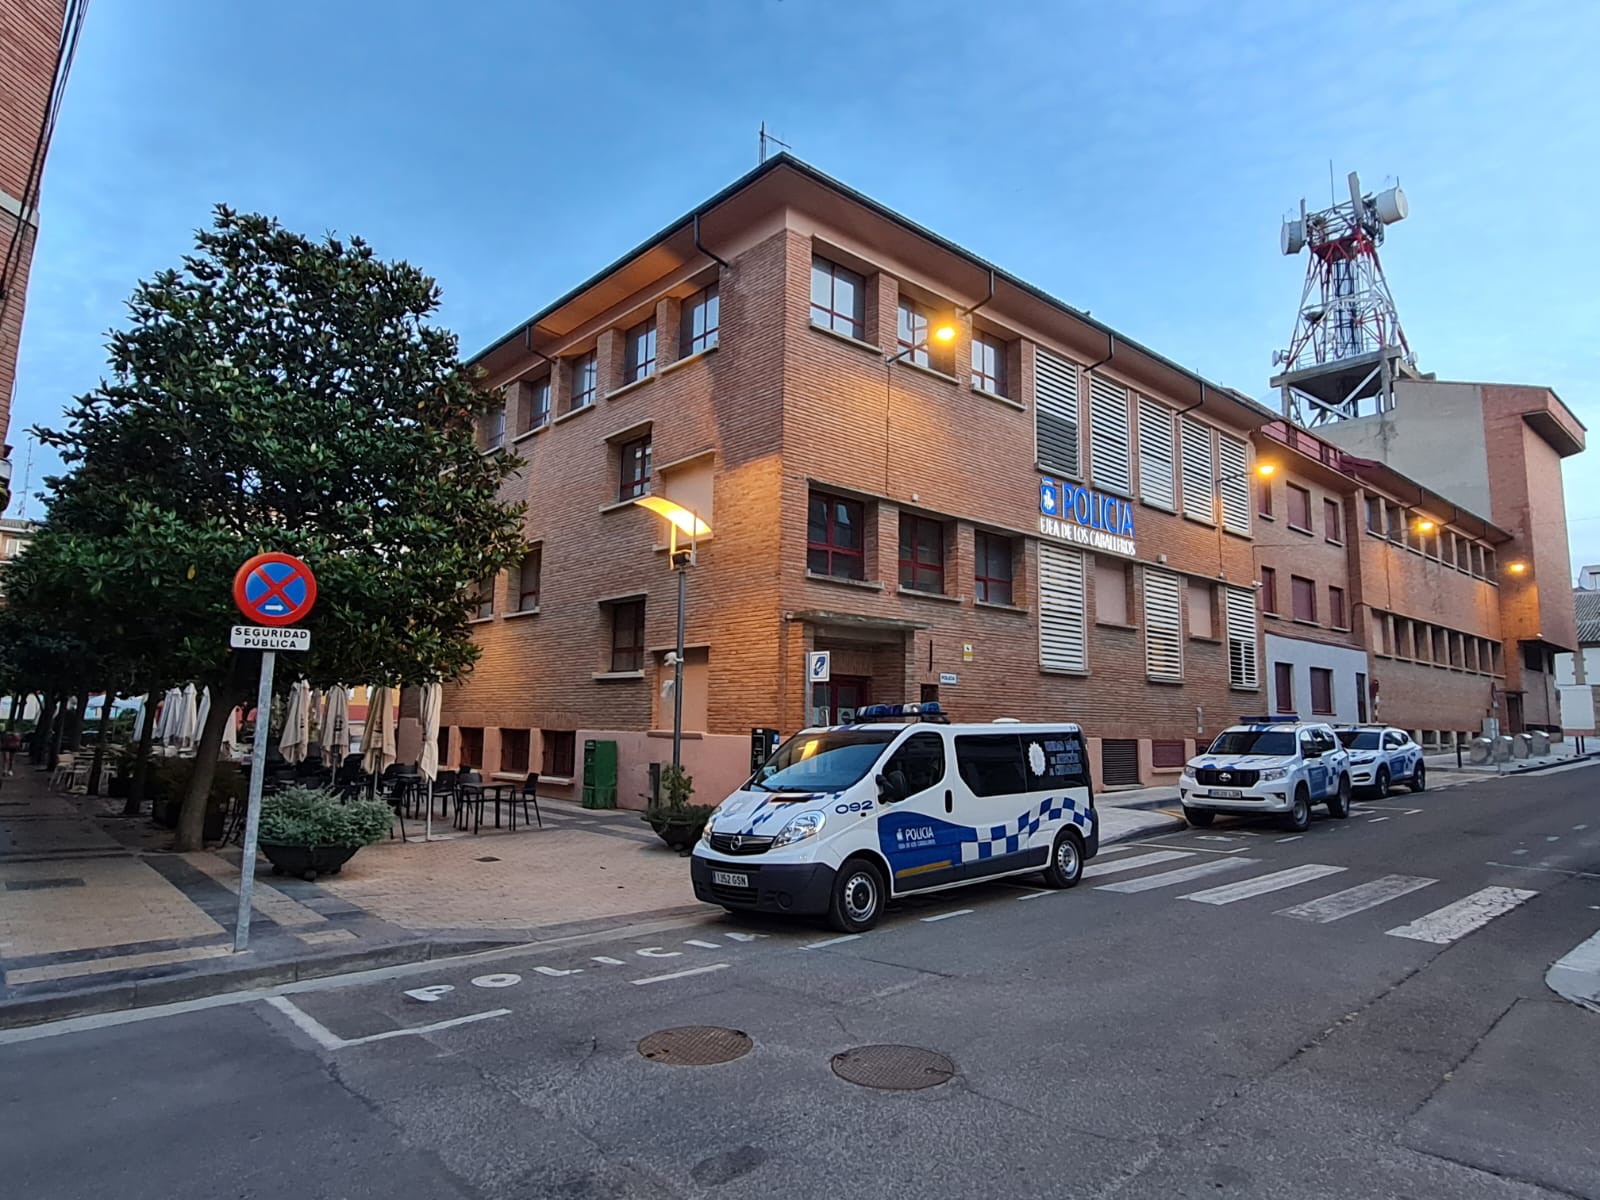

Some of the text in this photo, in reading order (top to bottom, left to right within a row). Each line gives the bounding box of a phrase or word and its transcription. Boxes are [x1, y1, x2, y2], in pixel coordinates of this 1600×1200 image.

[1062, 482, 1135, 539] POLICIA
[1040, 516, 1060, 538] EJEA
[1061, 523, 1073, 540] DE
[1074, 525, 1089, 545] LOS
[234, 627, 308, 639] SEGURIDAD
[244, 638, 297, 649] PUBLICA
[835, 800, 874, 815] 092
[905, 826, 935, 841] POLICIA
